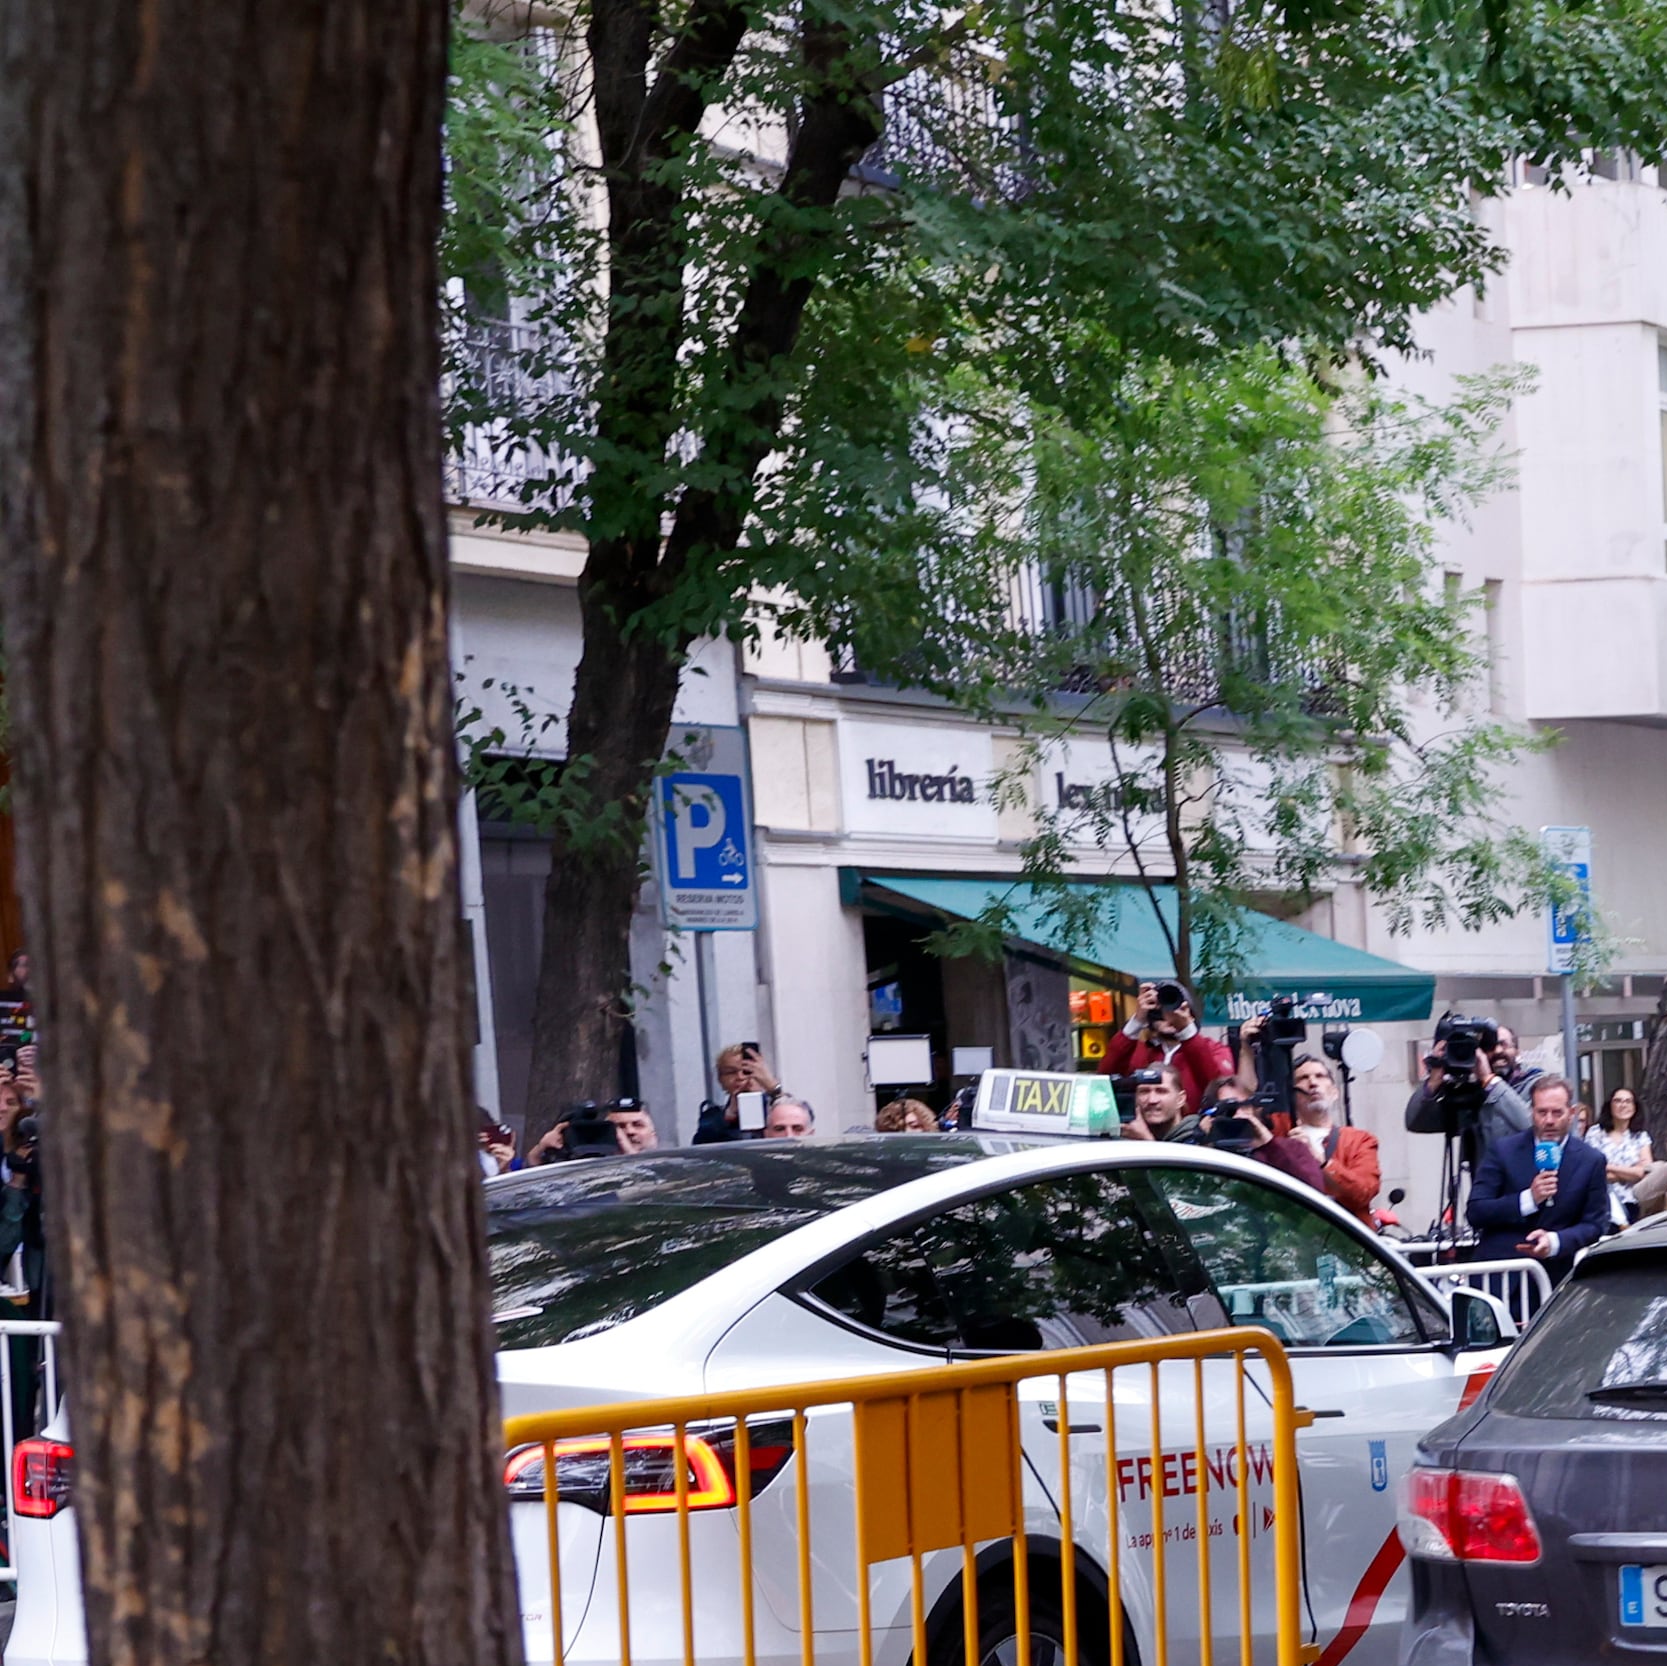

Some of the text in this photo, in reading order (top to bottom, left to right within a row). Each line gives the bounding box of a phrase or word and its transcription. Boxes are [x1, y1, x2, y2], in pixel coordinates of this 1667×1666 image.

[865, 758, 976, 804] librería
[672, 783, 726, 879] P
[1226, 991, 1291, 1020] libre
[1015, 1079, 1072, 1115] TAXI
[1126, 1534, 1137, 1549] La
[1182, 1522, 1197, 1541] de
[1495, 1602, 1551, 1618] TOYOTA
[1628, 1601, 1639, 1615] E
